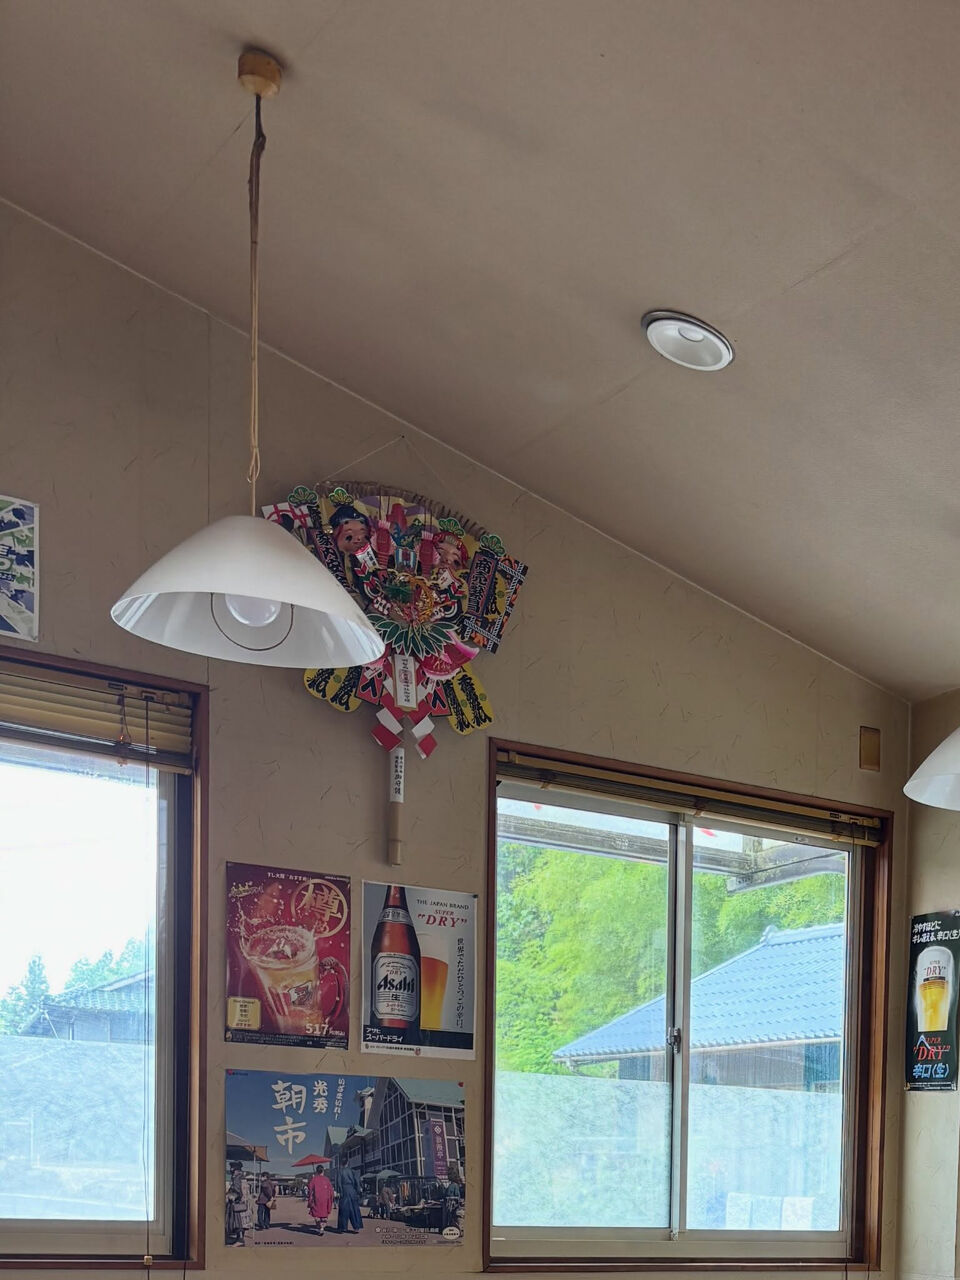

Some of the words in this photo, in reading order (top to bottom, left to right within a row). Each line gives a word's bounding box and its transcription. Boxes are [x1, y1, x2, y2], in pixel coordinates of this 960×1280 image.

[416, 898, 428, 906] THE
[429, 900, 448, 908] JAPAN
[376, 973, 416, 994] Asahi
[391, 993, 401, 1001] 生
[366, 1033, 404, 1043] スーパードライ
[312, 1079, 329, 1114] 光秀
[271, 1079, 308, 1155] 朝市
